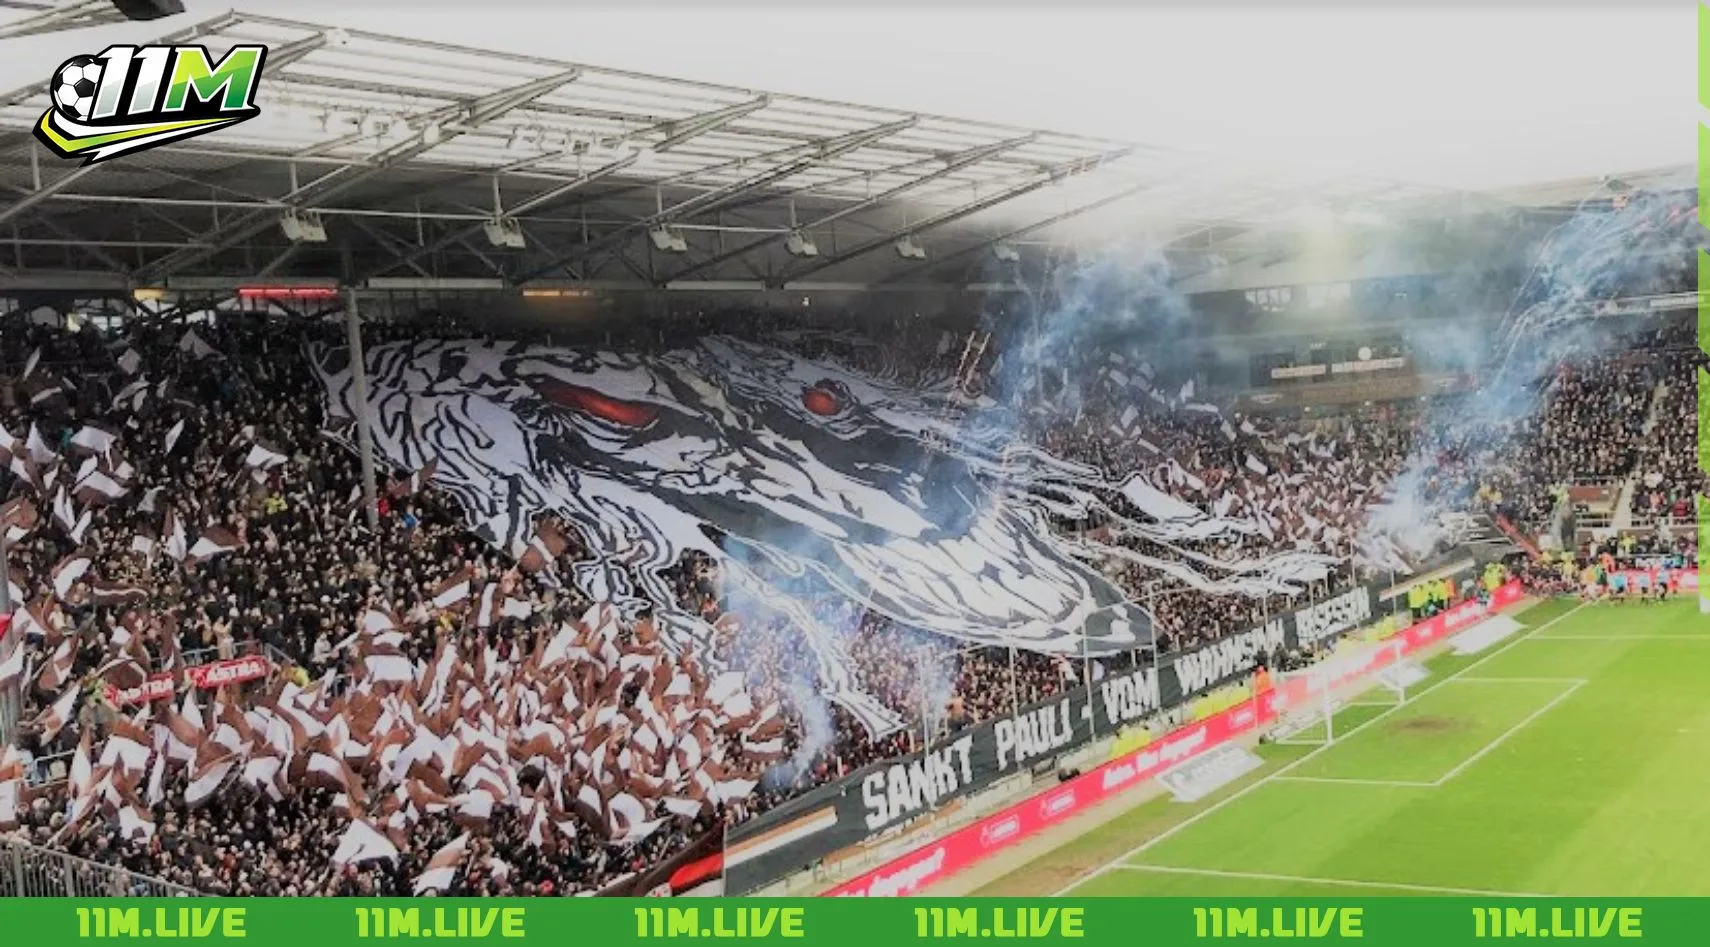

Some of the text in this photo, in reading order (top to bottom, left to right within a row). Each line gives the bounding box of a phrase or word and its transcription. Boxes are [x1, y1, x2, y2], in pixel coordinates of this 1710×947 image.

[862, 733, 973, 831] SANKT
[994, 697, 1074, 771] PAULI
[1102, 666, 1161, 725] VOM
